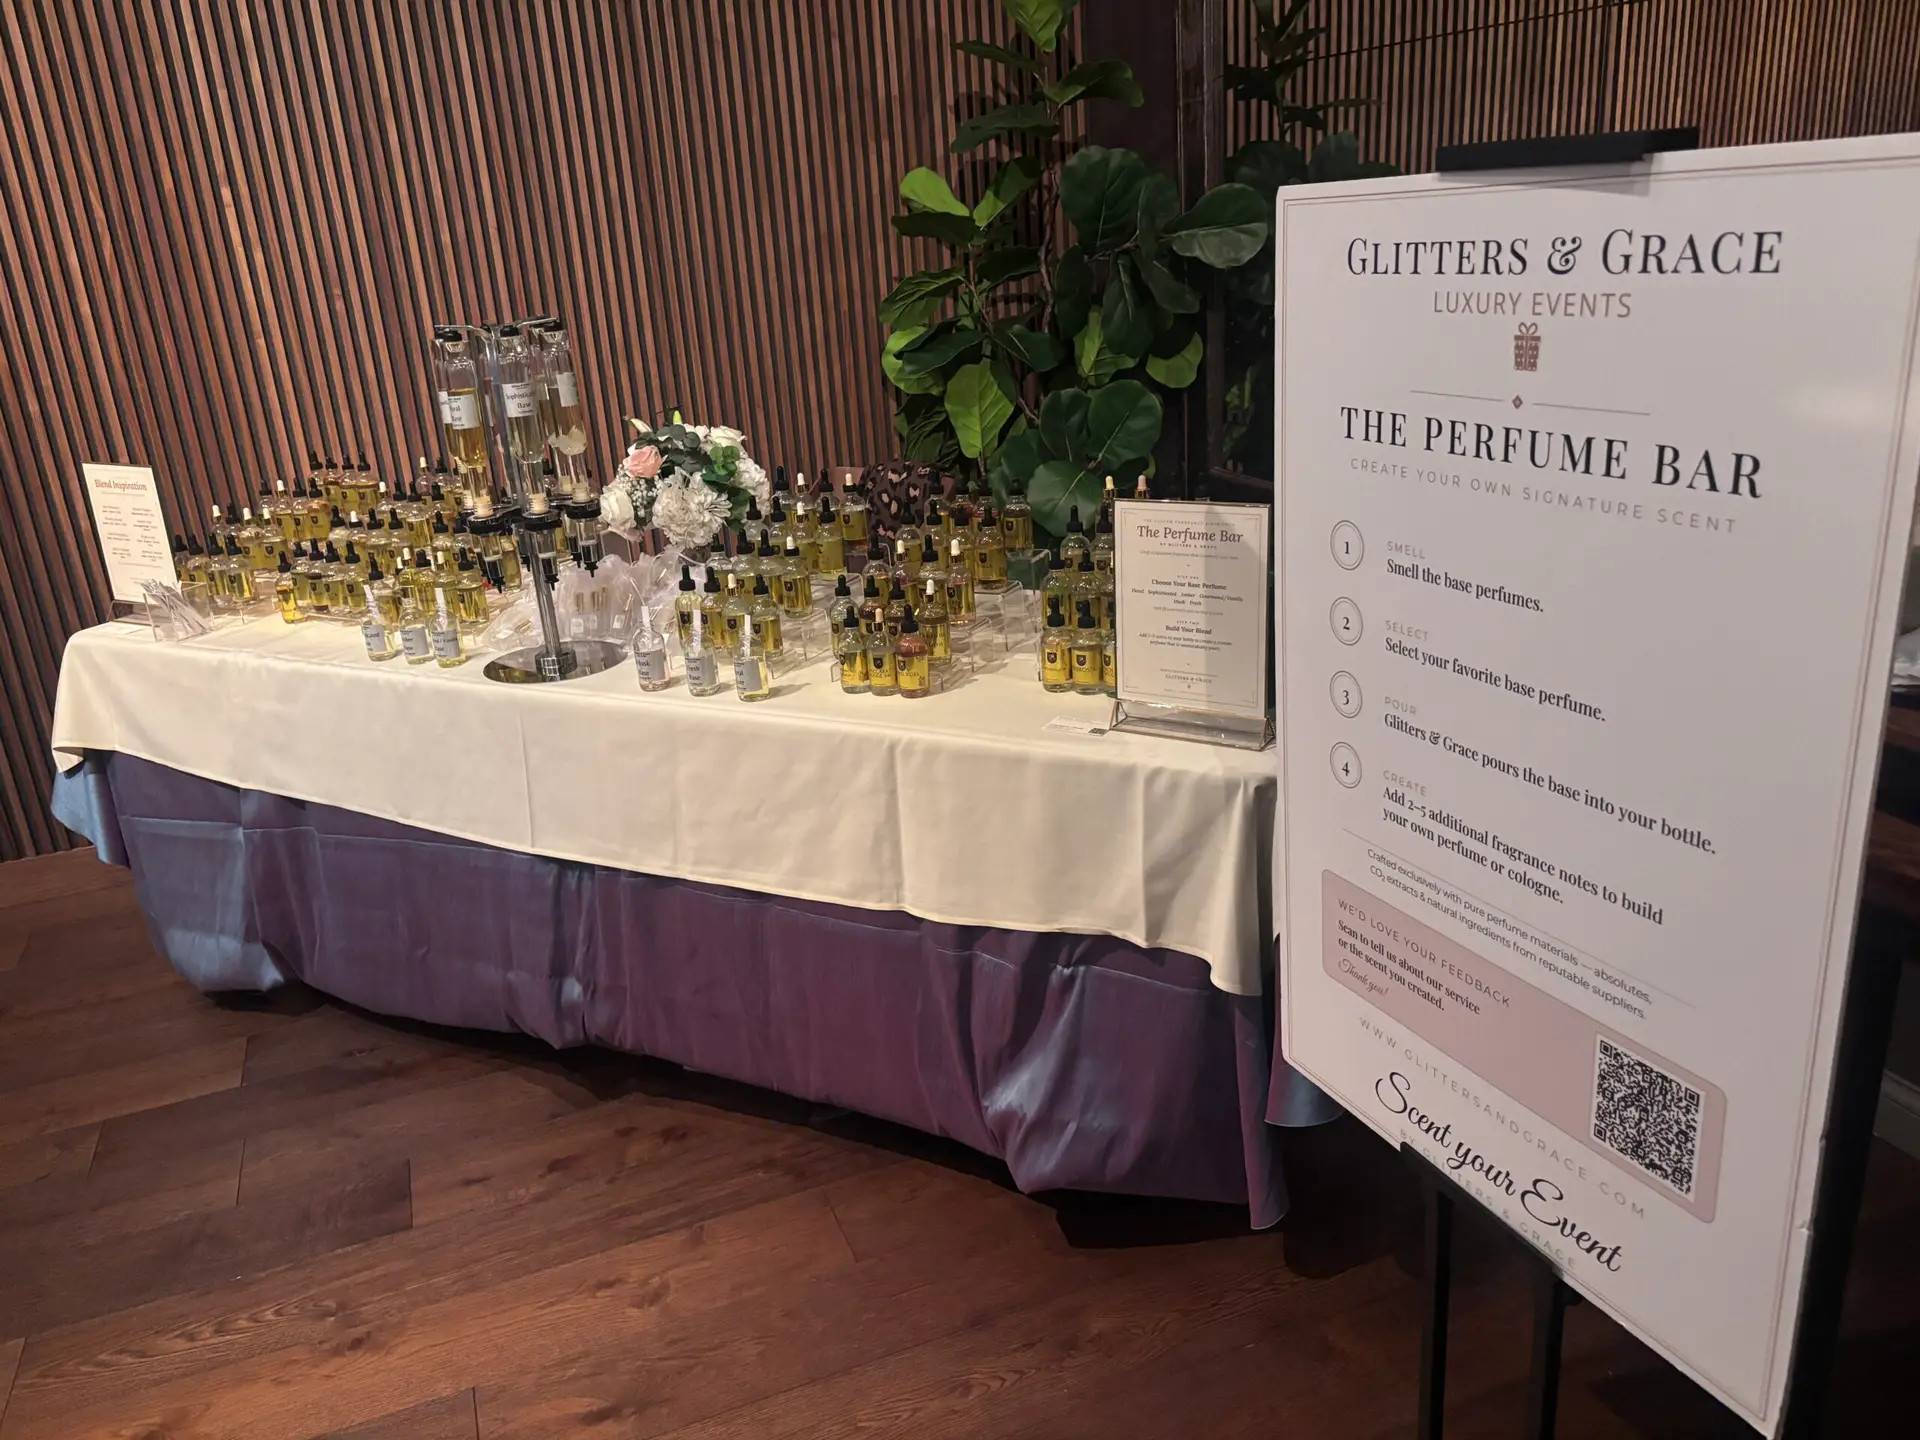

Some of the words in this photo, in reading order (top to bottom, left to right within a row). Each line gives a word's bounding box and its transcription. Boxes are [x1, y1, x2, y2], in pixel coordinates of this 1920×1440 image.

[1347, 237, 1529, 276] GLITTERS
[1547, 236, 1582, 276] &
[1602, 228, 1783, 275] GRACE
[1433, 291, 1522, 315] LUXURY
[1532, 292, 1632, 318] EVENTS
[1340, 406, 1407, 447] THE
[1423, 416, 1628, 480] PERFUME
[1652, 443, 1762, 499] BAR
[94, 479, 113, 489] Blend
[113, 480, 148, 492] Inspiration
[1350, 457, 1408, 478] CREATE
[1416, 468, 1461, 488] YOUR
[1470, 478, 1512, 496] OWN
[1522, 486, 1644, 519] SIGNATURE
[1657, 508, 1736, 533] SCENT
[1136, 525, 1160, 538] The
[1163, 526, 1216, 544] Perfume
[1219, 529, 1244, 543] Bar
[1343, 541, 1351, 555] 1
[1386, 541, 1426, 560] SMELL
[1151, 578, 1172, 587] Choose
[1173, 580, 1186, 588] Your
[1187, 581, 1201, 589] Base
[1202, 582, 1227, 591] Perfume
[1386, 558, 1419, 579] Smell
[1421, 566, 1441, 585] the
[1444, 571, 1472, 593] base
[1475, 584, 1544, 613] perfumes.
[1195, 627, 1212, 635] Blend
[1342, 617, 1350, 630] 2
[1385, 620, 1429, 641] SELECT
[1342, 689, 1350, 705] 3
[1385, 637, 1419, 660] Select
[1421, 651, 1450, 670] your
[1452, 657, 1501, 687] favorite
[1504, 673, 1535, 698] base
[1538, 688, 1606, 722] perfume.
[1384, 696, 1417, 715] POUR
[1341, 761, 1350, 776] 4
[1382, 770, 1427, 797] CREATE
[1384, 713, 1426, 741] Glitters
[1429, 730, 1440, 745] &
[1443, 735, 1479, 761] Grace
[1482, 752, 1519, 778] pours
[1523, 767, 1545, 787] the
[1548, 775, 1581, 802] base
[1584, 789, 1615, 815] into
[1618, 805, 1657, 831] your
[1660, 817, 1716, 855] bottle.
[1382, 807, 1409, 827] your
[1410, 821, 1434, 842] own
[1436, 833, 1488, 867] perfume
[1490, 859, 1505, 876] or
[1507, 867, 1564, 904] cologne.
[1382, 786, 1405, 807] Add
[1428, 808, 1489, 846] additional
[1491, 834, 1555, 876] fragrance
[1559, 868, 1599, 896] notes
[1602, 885, 1617, 904] to
[1621, 892, 1664, 926] build
[1367, 848, 1397, 871] Crafted
[1397, 865, 1442, 896] exclusively
[1442, 889, 1462, 905] with
[1463, 900, 1485, 919] pure
[1486, 912, 1529, 940] perfume
[1530, 934, 1579, 966] materials
[1593, 966, 1653, 1006] absolutes,
[1386, 874, 1418, 898] extracts
[1419, 891, 1426, 902] &
[1427, 896, 1458, 919] natural
[1459, 913, 1512, 949] ingredients
[1512, 941, 1538, 963] from
[1538, 956, 1591, 991] reputable
[1337, 957, 1369, 986] Thank
[1367, 982, 1390, 997] you!
[1338, 919, 1358, 941] Scan
[1359, 932, 1369, 946] to
[1370, 939, 1385, 957] tell
[1386, 949, 1398, 964] us
[1398, 958, 1424, 981] about
[1426, 975, 1444, 991] our
[1445, 987, 1481, 1016] service
[1338, 937, 1349, 949] or
[1349, 942, 1364, 959] the
[1364, 954, 1388, 976] scent
[1389, 969, 1406, 987] you
[1407, 982, 1445, 1012] created.
[1370, 917, 1399, 942] LOVE
[1403, 936, 1437, 964] YOUR
[1441, 958, 1511, 1008] FEEDBACK
[1375, 1071, 1453, 1149] Scent
[1446, 1141, 1516, 1197] your
[1520, 1178, 1623, 1273] Event
